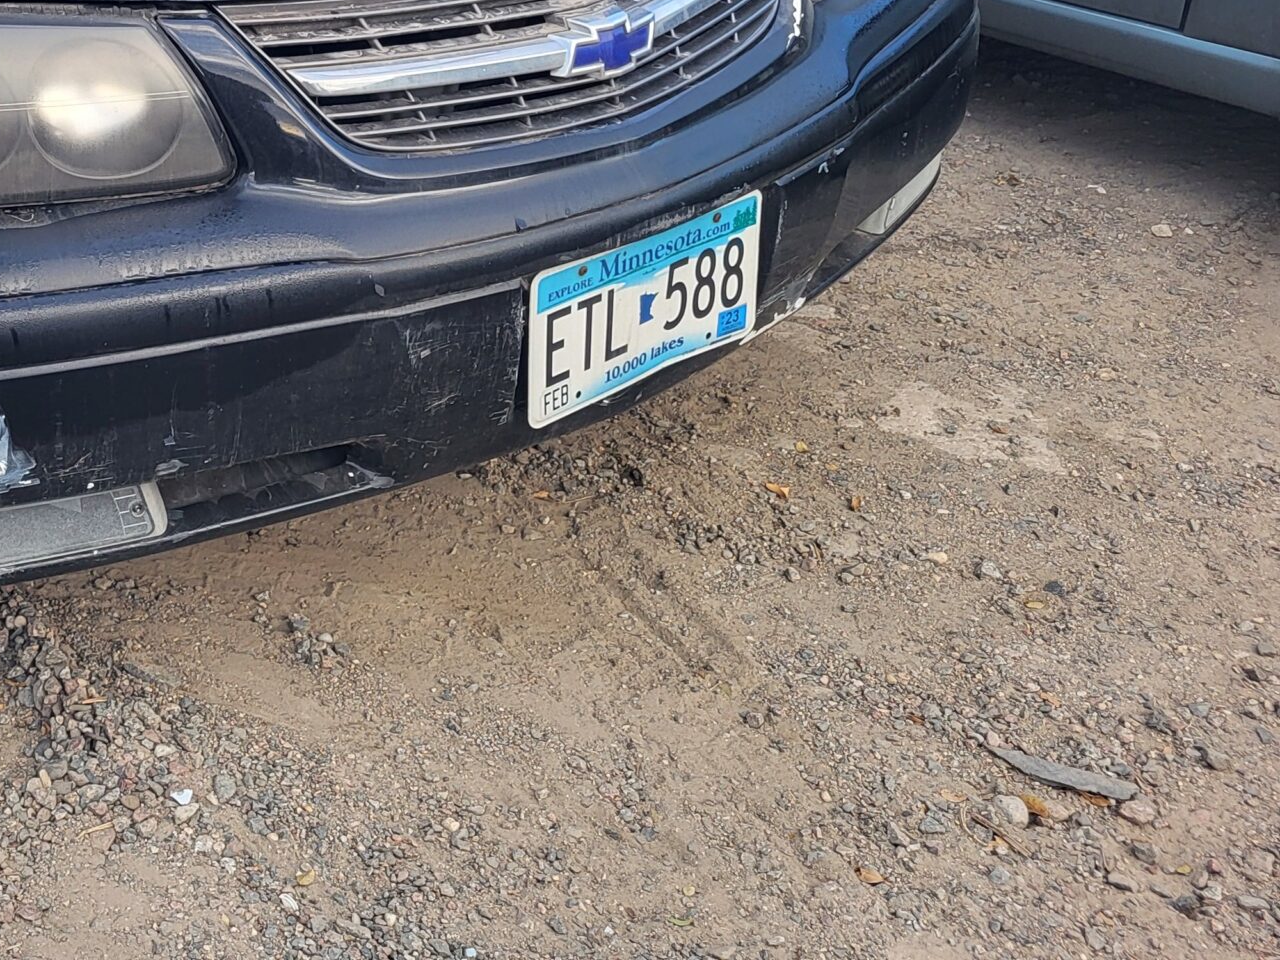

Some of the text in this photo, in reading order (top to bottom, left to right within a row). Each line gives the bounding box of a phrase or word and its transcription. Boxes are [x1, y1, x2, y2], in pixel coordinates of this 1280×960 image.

[548, 222, 731, 302] EXPLORE Minnesota.com
[546, 237, 744, 388] ETL 588
[725, 309, 739, 325] 23
[605, 337, 684, 383] 10,000 lakes
[543, 384, 569, 416] FEB
